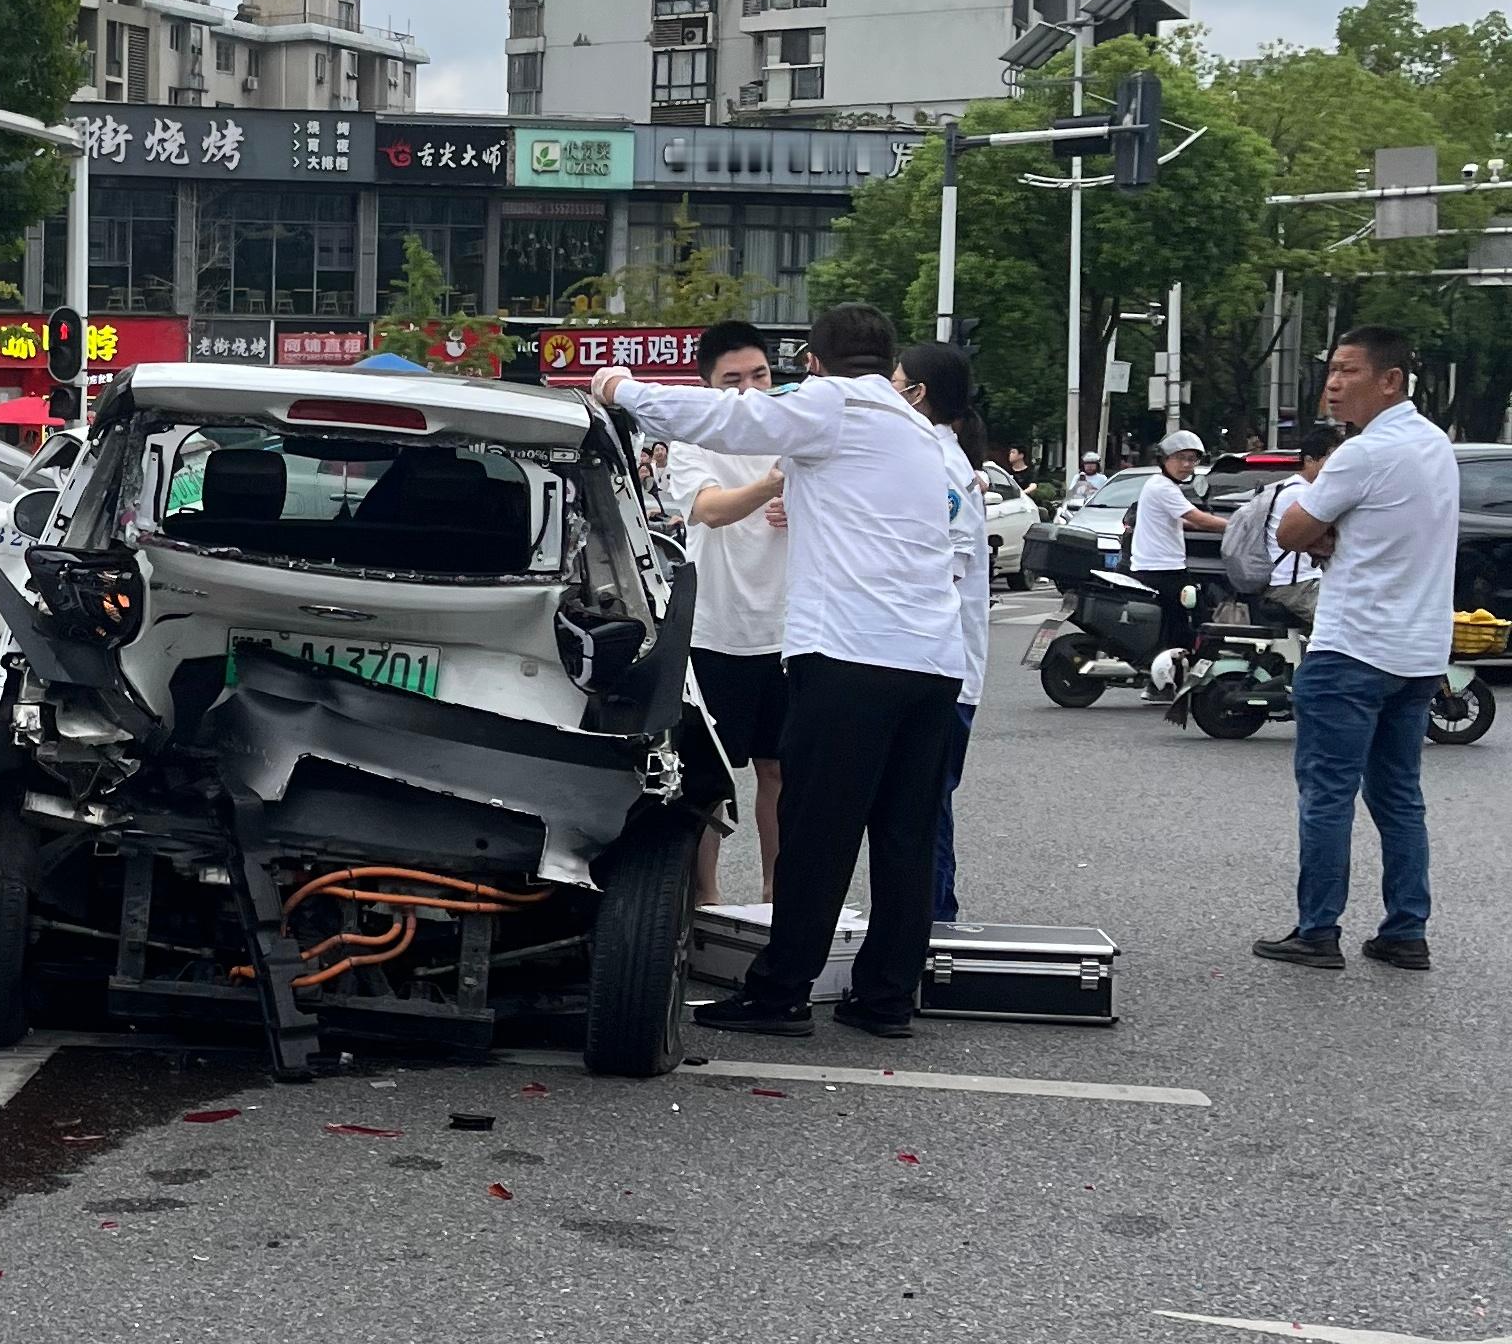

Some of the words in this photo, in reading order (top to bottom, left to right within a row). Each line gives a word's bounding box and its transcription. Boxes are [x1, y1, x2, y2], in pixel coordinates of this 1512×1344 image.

[88, 114, 245, 171] 街烧烤
[417, 142, 503, 174] 舌尖大师
[566, 162, 610, 176] UZERO
[196, 336, 267, 358] 老街烧烤
